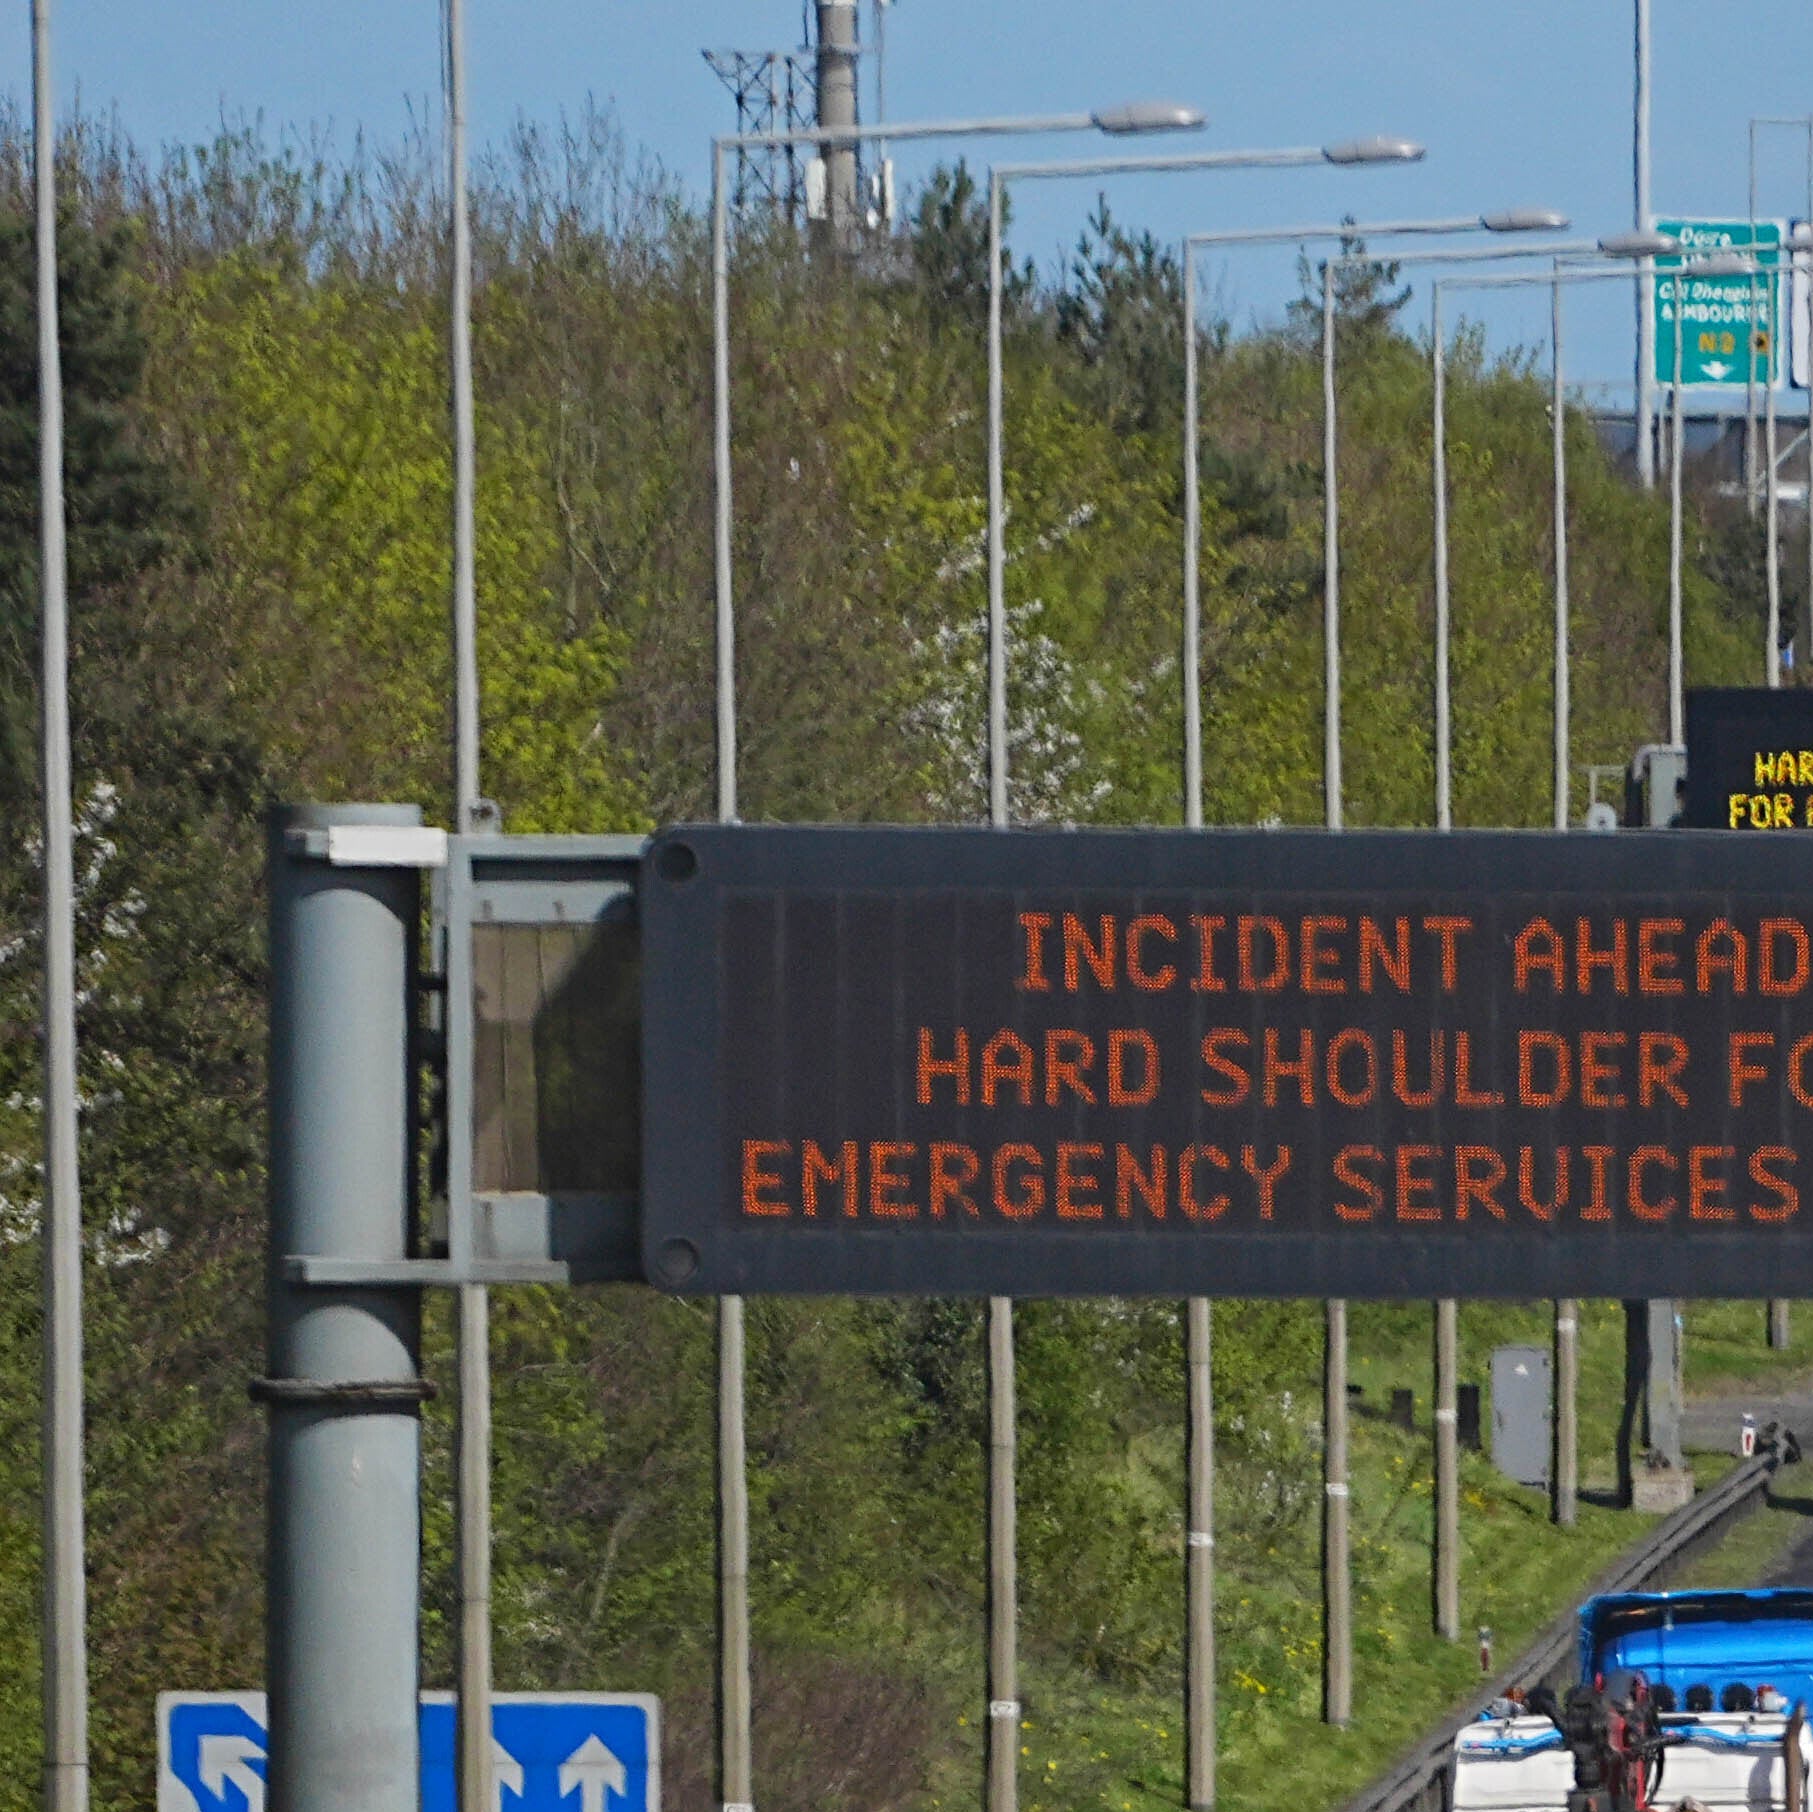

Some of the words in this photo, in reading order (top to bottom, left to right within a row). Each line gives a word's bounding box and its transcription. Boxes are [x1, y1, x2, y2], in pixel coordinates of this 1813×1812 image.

[1729, 793, 1794, 829] FOR
[1016, 912, 1473, 994] INCIDENT
[1512, 917, 1811, 996] AHEAD
[914, 1027, 1161, 1108] HARD
[1203, 1028, 1690, 1108] SHOULDER
[739, 1138, 1296, 1222] EMERGENCY
[1333, 1140, 1800, 1222] SERVICES
